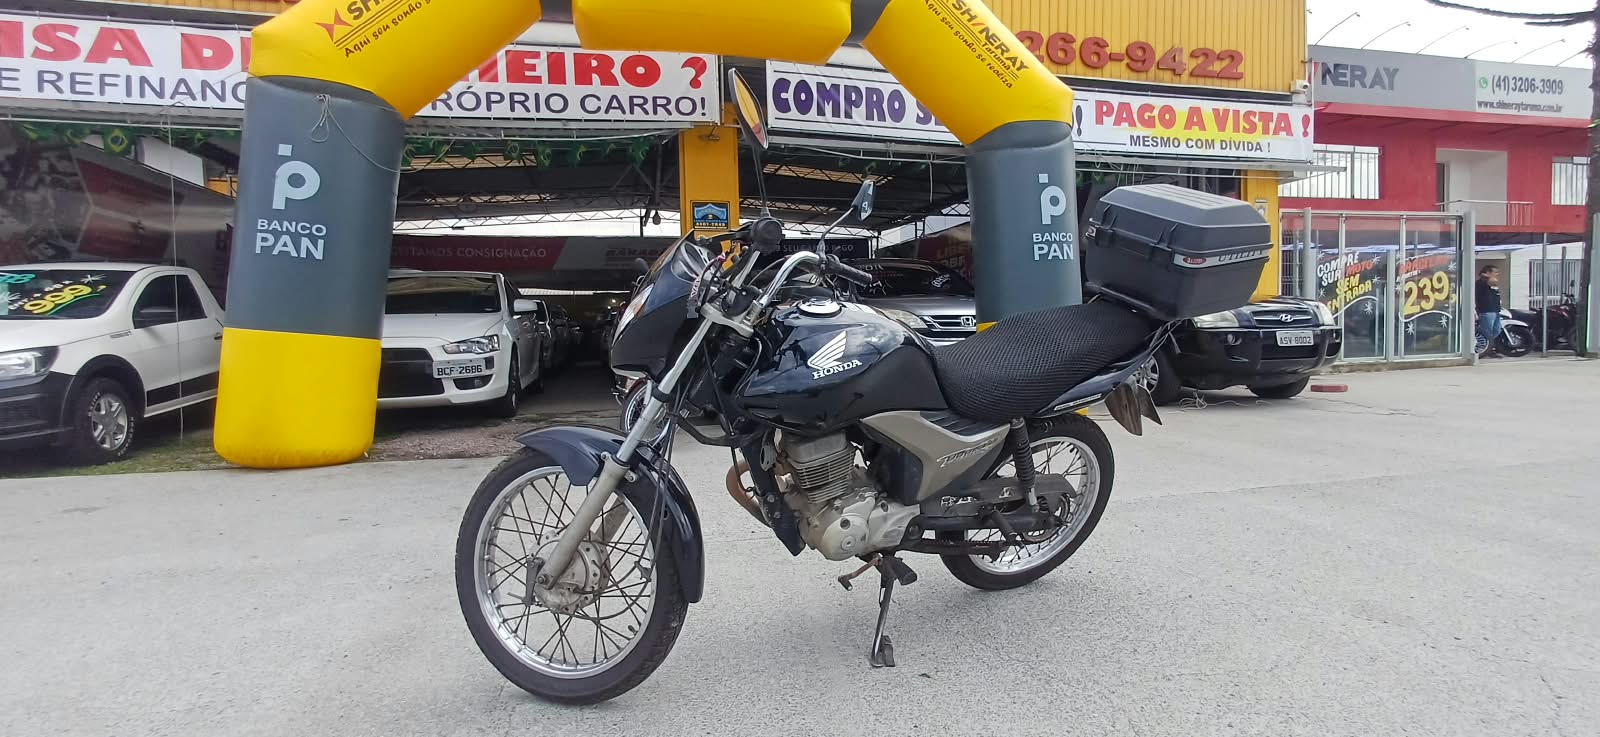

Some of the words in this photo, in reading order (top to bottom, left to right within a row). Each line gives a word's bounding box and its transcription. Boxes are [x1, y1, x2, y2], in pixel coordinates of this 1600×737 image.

[344, 34, 372, 58] Aqui
[372, 24, 391, 40] seu
[391, 1, 423, 27] sonho
[181, 33, 252, 73] D
[940, 16, 955, 31] seu
[954, 30, 977, 54] sonho
[976, 53, 987, 63] se
[987, 62, 1013, 89] realiza
[37, 70, 247, 103] REFINANC
[431, 86, 569, 113] RÓPRIO
[580, 94, 706, 116] CARRO!
[772, 77, 906, 124] COMPRO
[1095, 100, 1177, 129] PAGO
[1184, 106, 1207, 132] A
[1212, 108, 1294, 136] VISTA
[1130, 135, 1181, 149] MESMO
[1185, 138, 1216, 151] COM
[1220, 137, 1263, 152] DÍVIDA
[257, 219, 327, 236] BANCO
[1033, 232, 1073, 242] BANCO
[255, 232, 325, 260] PAN
[1033, 243, 1074, 260] PAN
[1317, 253, 1360, 277] COMPRE
[1326, 280, 1372, 311] ENTRADA
[812, 359, 863, 380] HONDA
